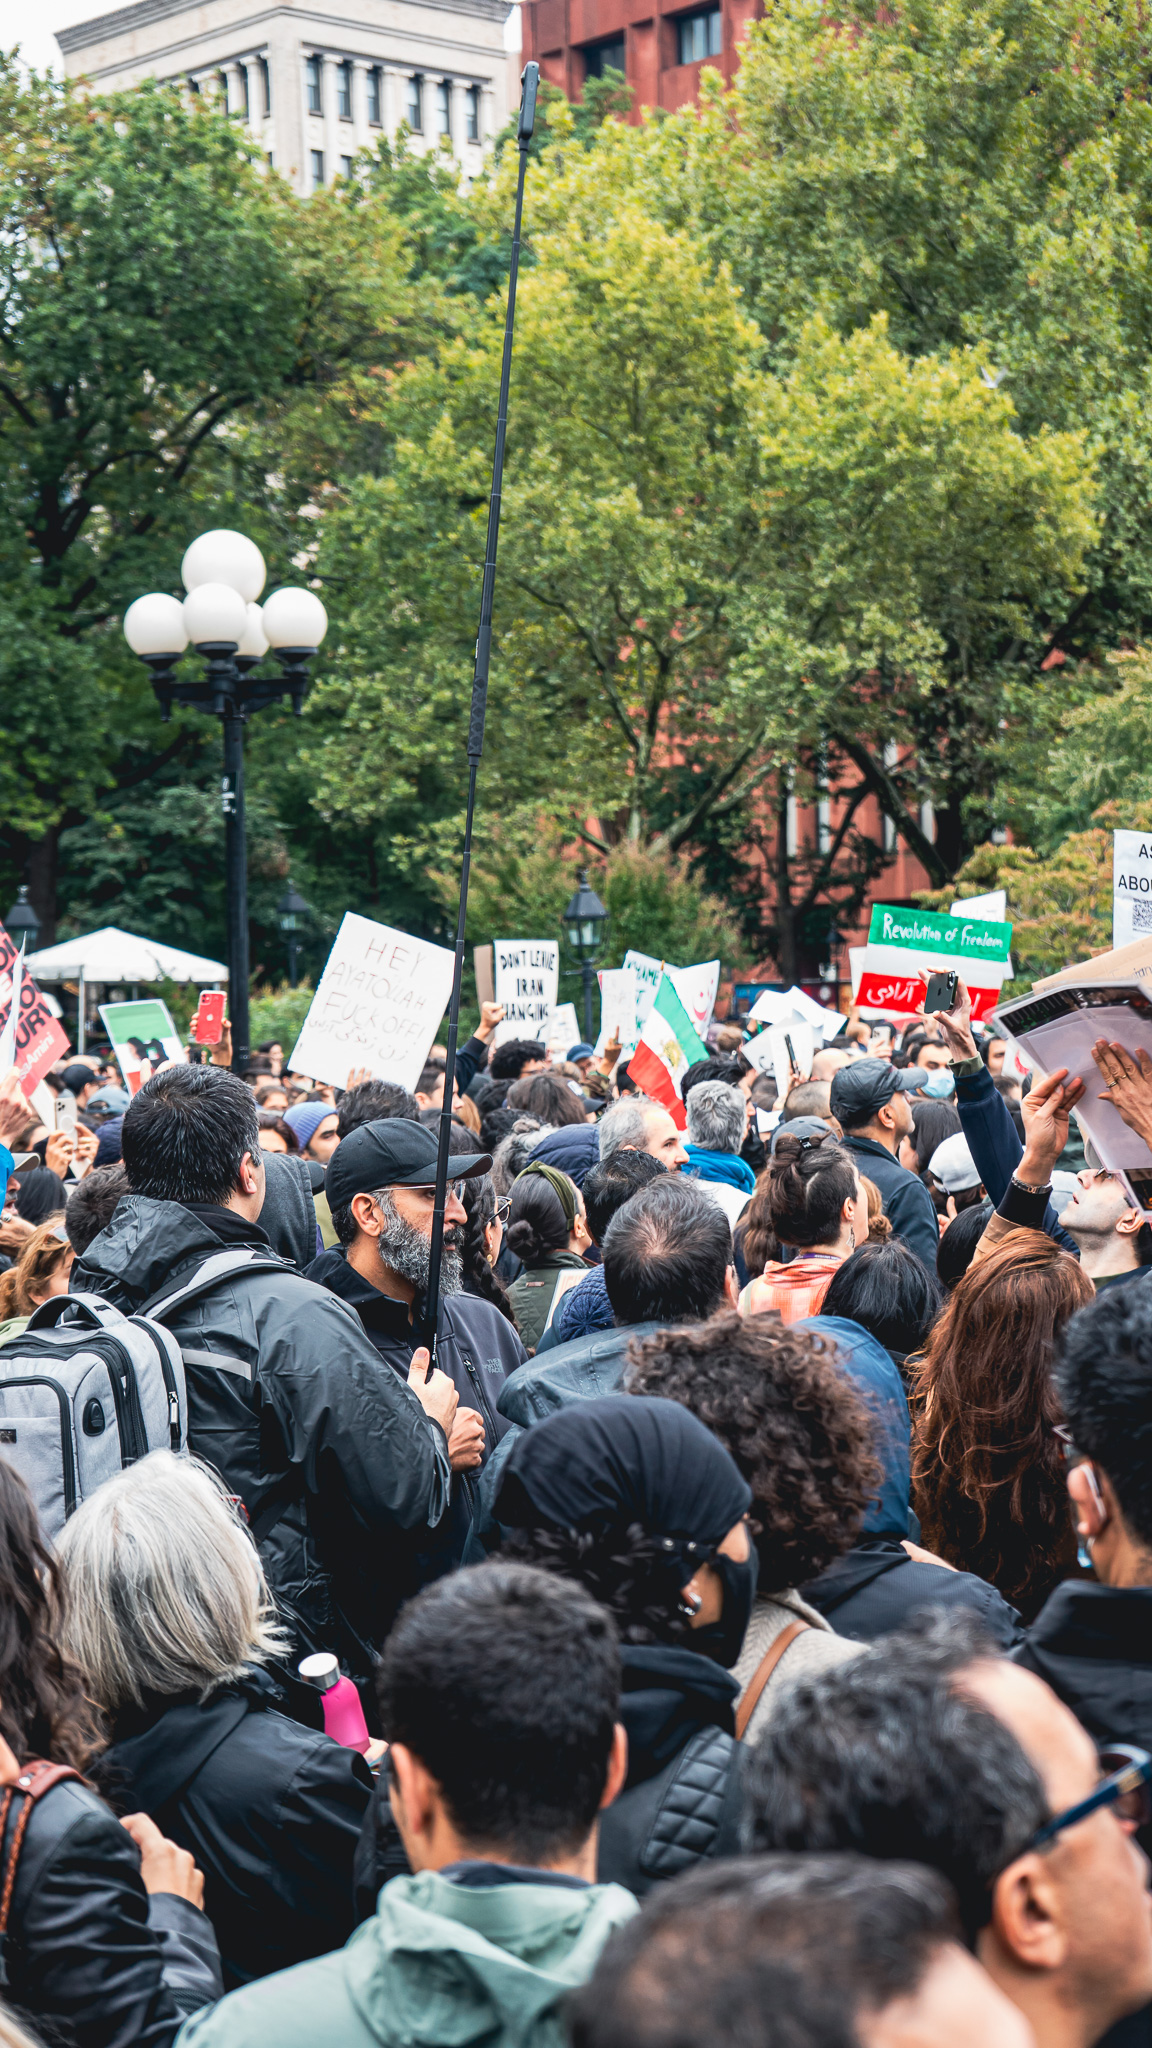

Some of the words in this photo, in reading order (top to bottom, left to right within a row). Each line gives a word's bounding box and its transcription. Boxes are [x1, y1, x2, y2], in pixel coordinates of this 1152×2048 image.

[1118, 874, 1152, 893] ABO
[882, 912, 941, 942] Revolution
[944, 927, 958, 942] of
[960, 924, 1003, 949] Freedom
[364, 937, 427, 978] HEY
[517, 978, 544, 997] IRAN
[322, 991, 380, 1029] FUCK
[382, 1015, 427, 1046] OFF!
